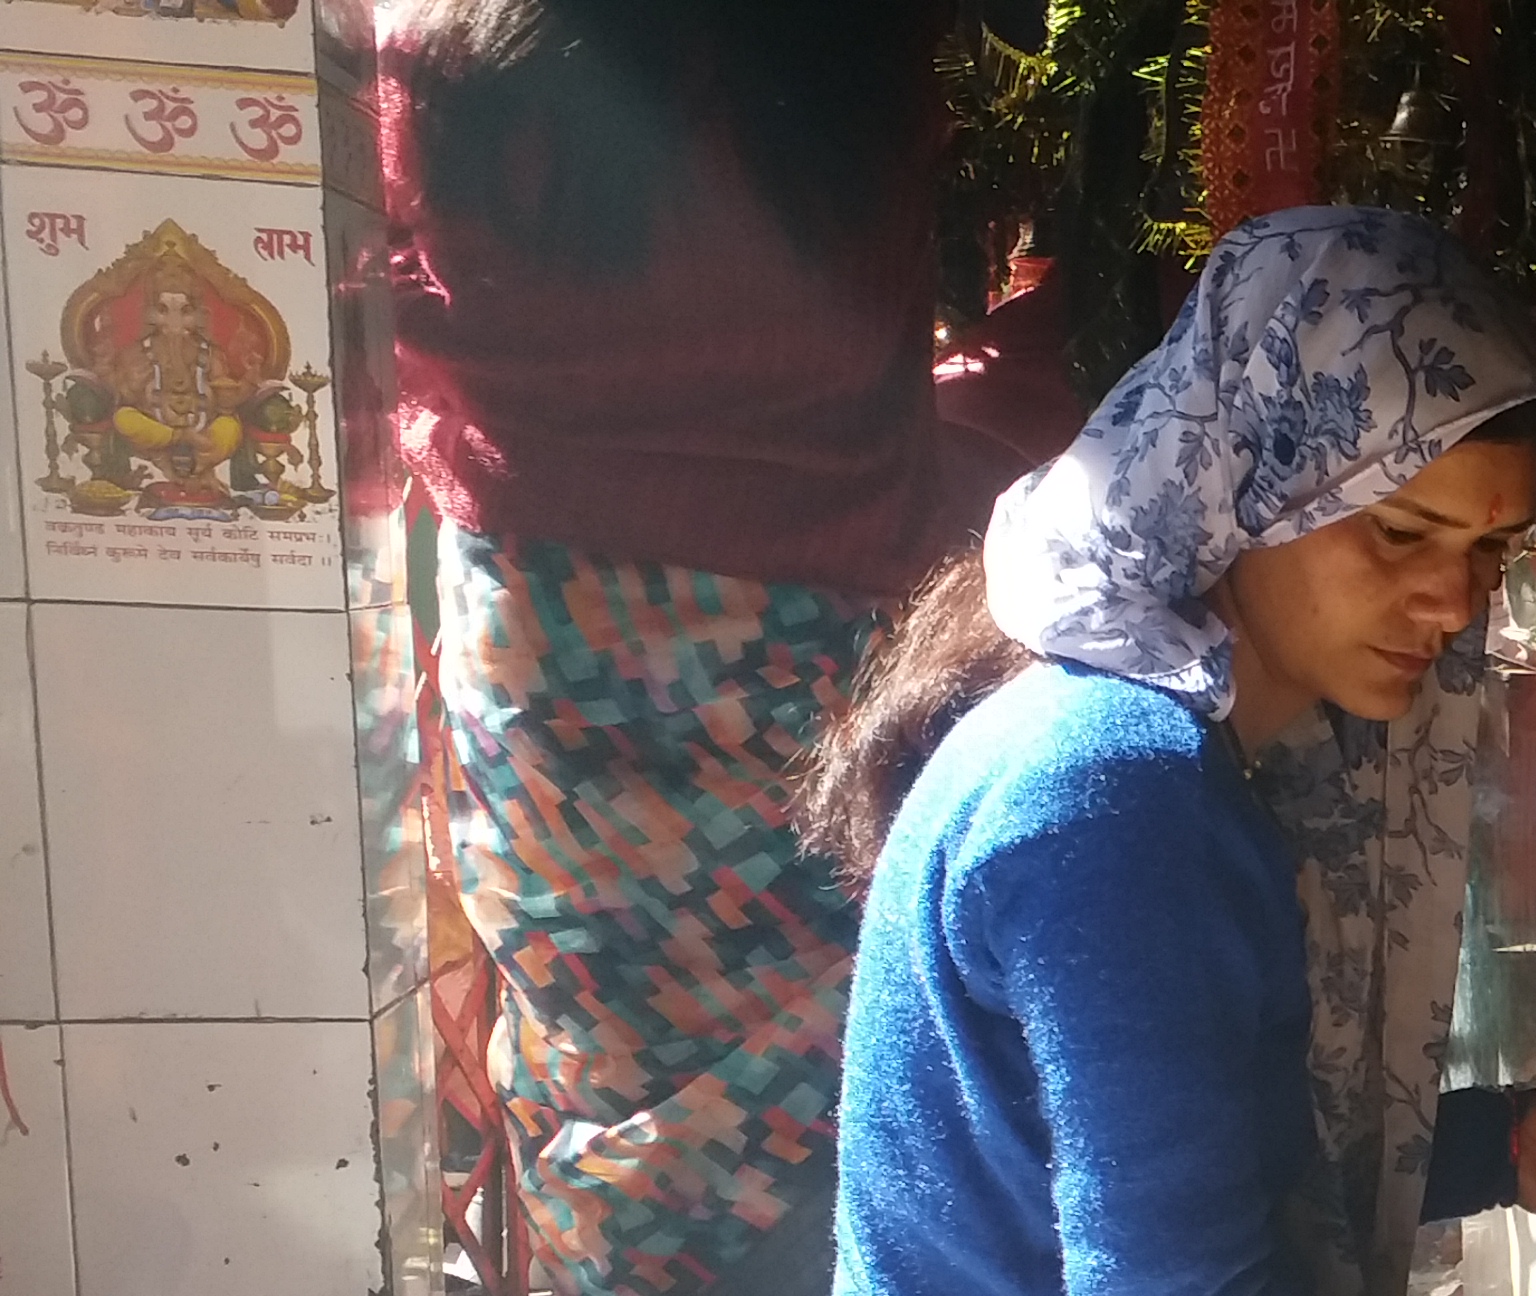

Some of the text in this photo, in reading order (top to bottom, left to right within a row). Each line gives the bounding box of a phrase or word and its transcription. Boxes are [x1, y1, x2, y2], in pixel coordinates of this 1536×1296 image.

[26, 211, 90, 257] शुभ
[252, 226, 317, 267] लाभ
[222, 524, 259, 541] कोटि
